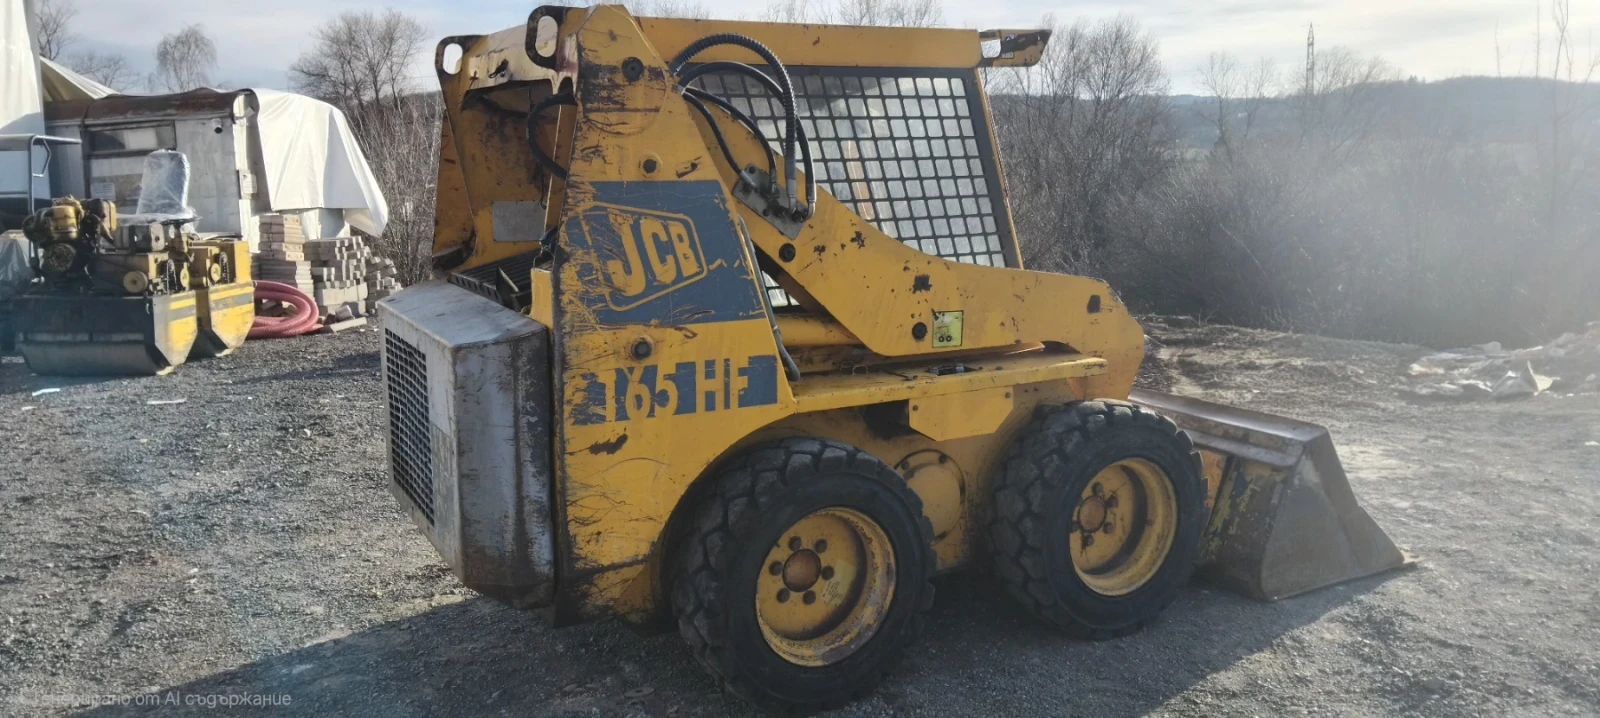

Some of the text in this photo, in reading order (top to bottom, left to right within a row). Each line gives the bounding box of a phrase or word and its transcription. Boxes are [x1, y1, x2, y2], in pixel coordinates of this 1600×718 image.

[608, 208, 700, 297] JCB
[599, 355, 749, 422] 165 HF
